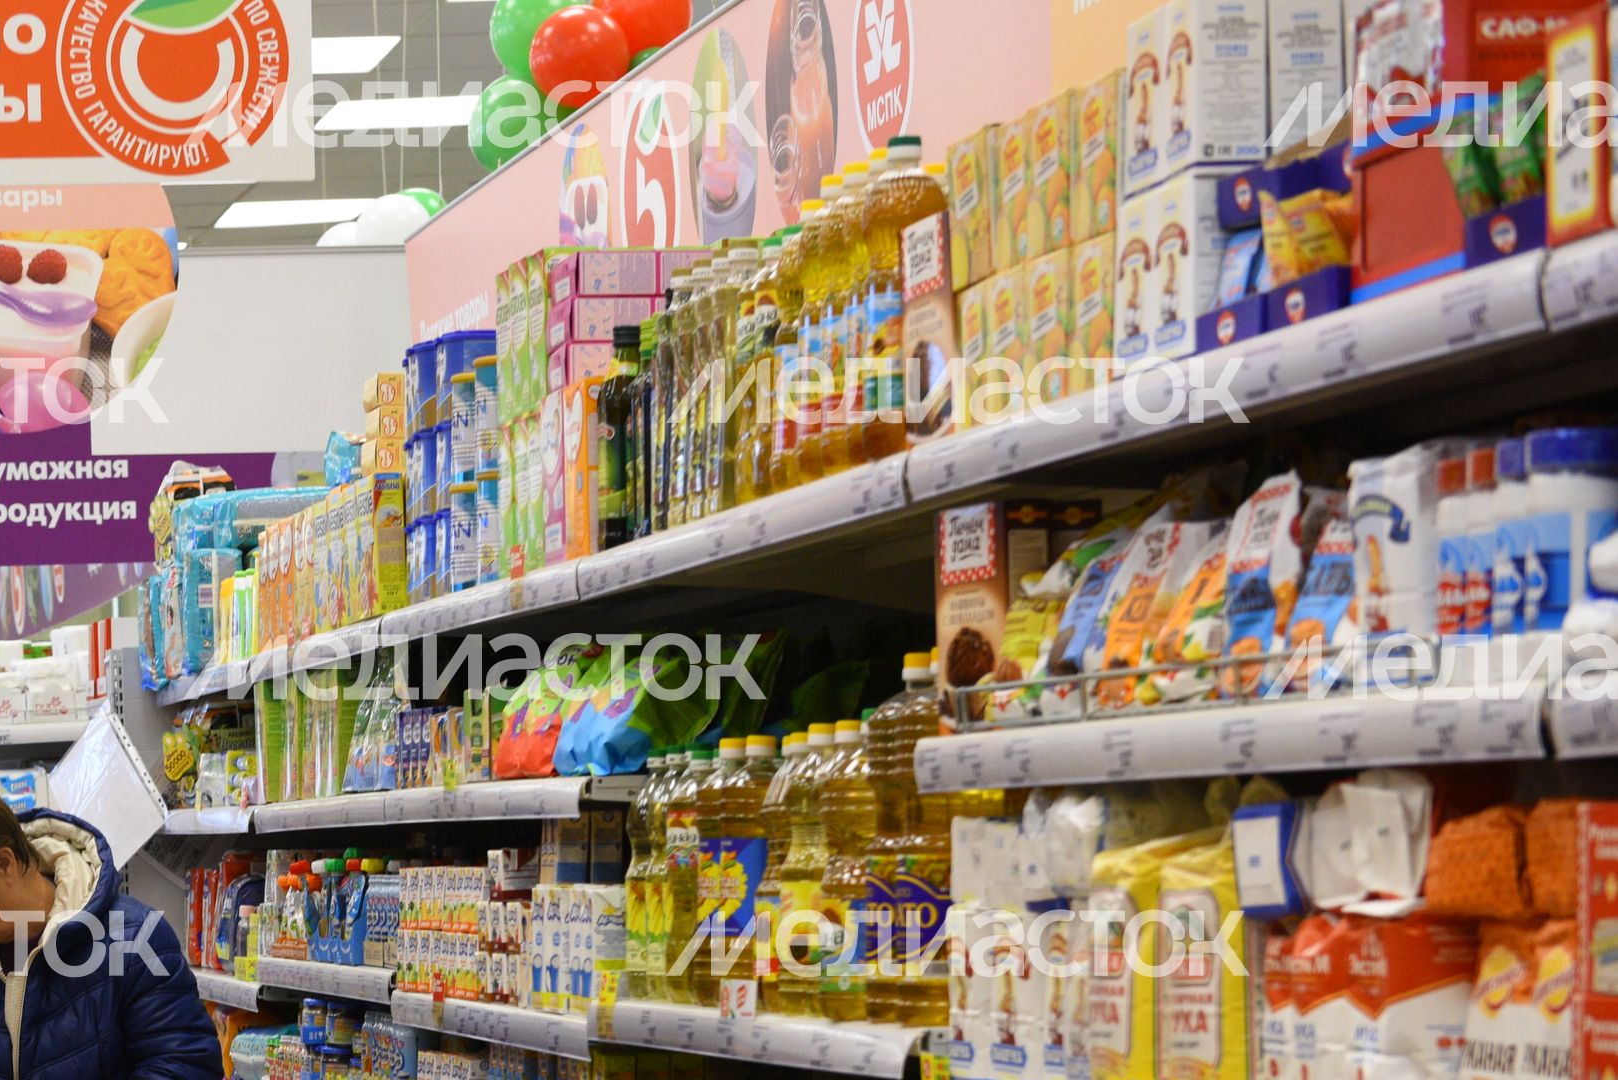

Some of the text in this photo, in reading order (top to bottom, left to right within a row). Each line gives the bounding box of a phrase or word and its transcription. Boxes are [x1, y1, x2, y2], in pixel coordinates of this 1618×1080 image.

[69, 0, 209, 168] КАЧЕСТВО ГАРАНТИРУЮ!
[241, 28, 280, 129] СВЕЖЕСТИ
[867, 85, 903, 132] МСПК
